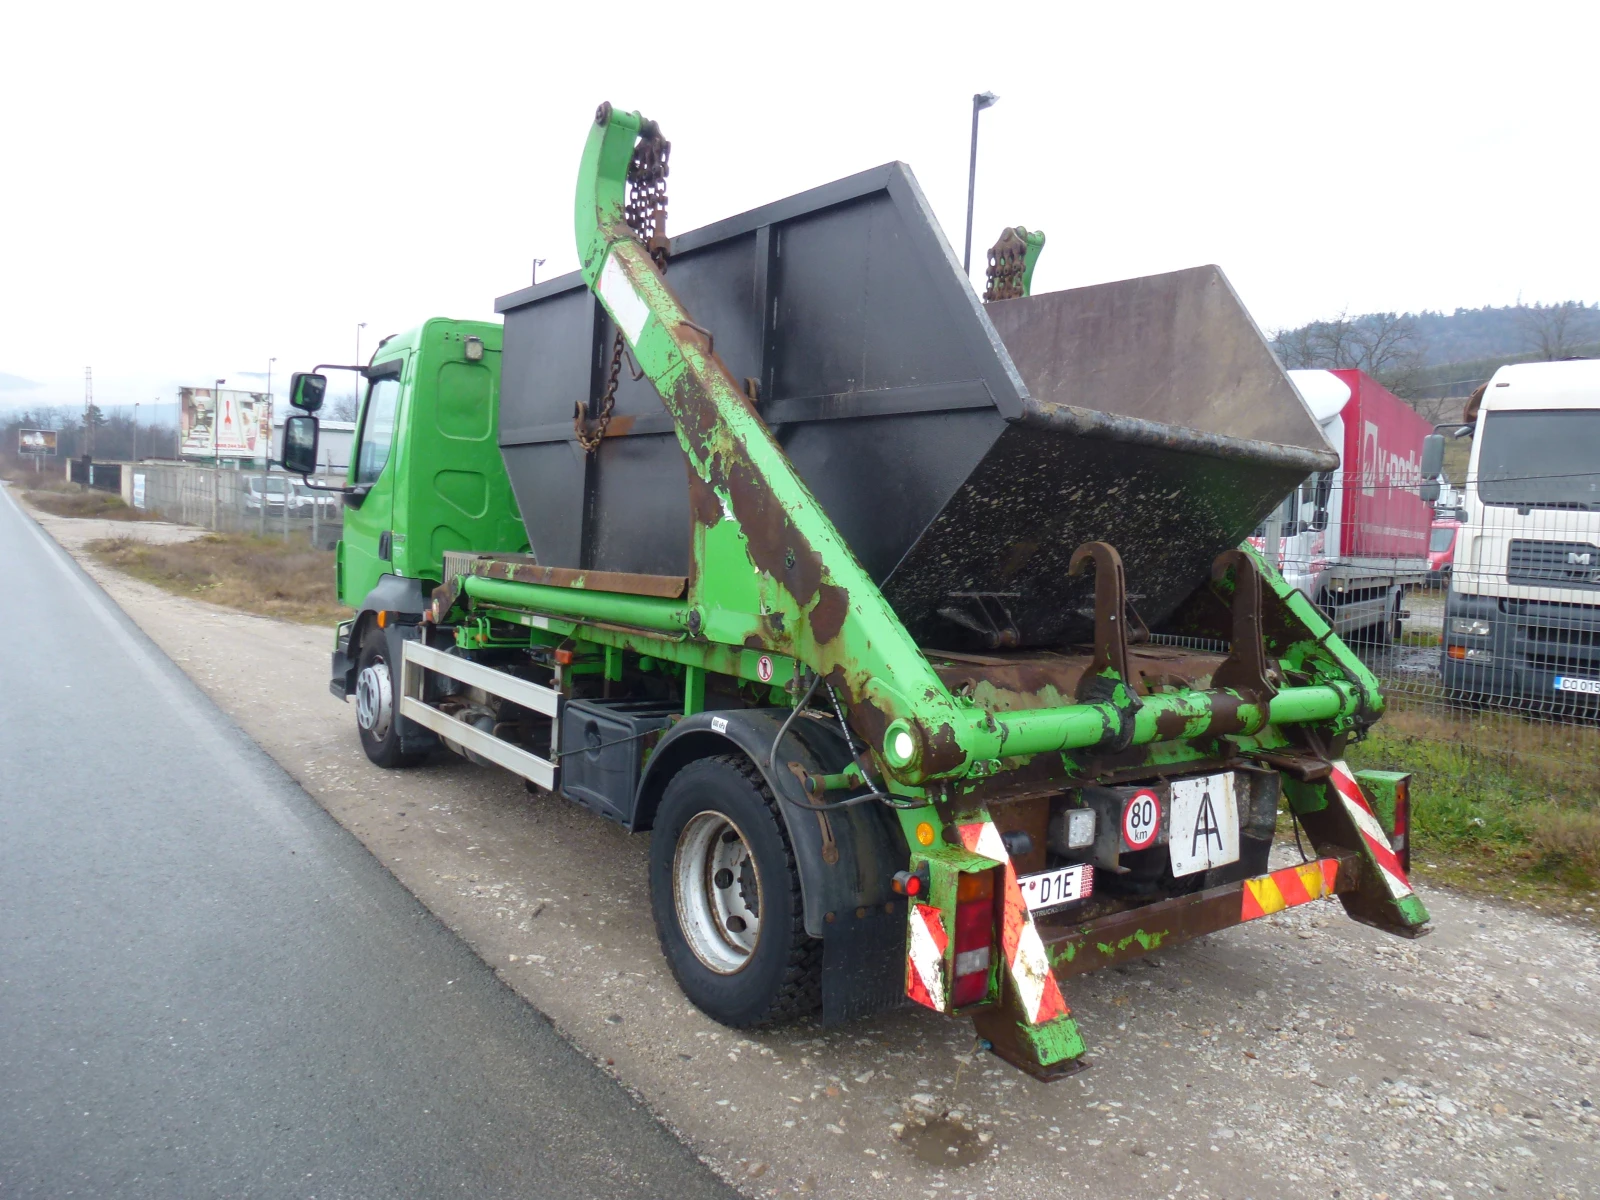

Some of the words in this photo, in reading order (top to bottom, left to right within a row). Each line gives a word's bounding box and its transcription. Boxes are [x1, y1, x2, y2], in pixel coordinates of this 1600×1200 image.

[1378, 446, 1424, 505] v-podla
[1131, 800, 1152, 829] 80
[1191, 792, 1223, 857] A
[1134, 829, 1148, 841] km
[1040, 872, 1074, 904] D1E
